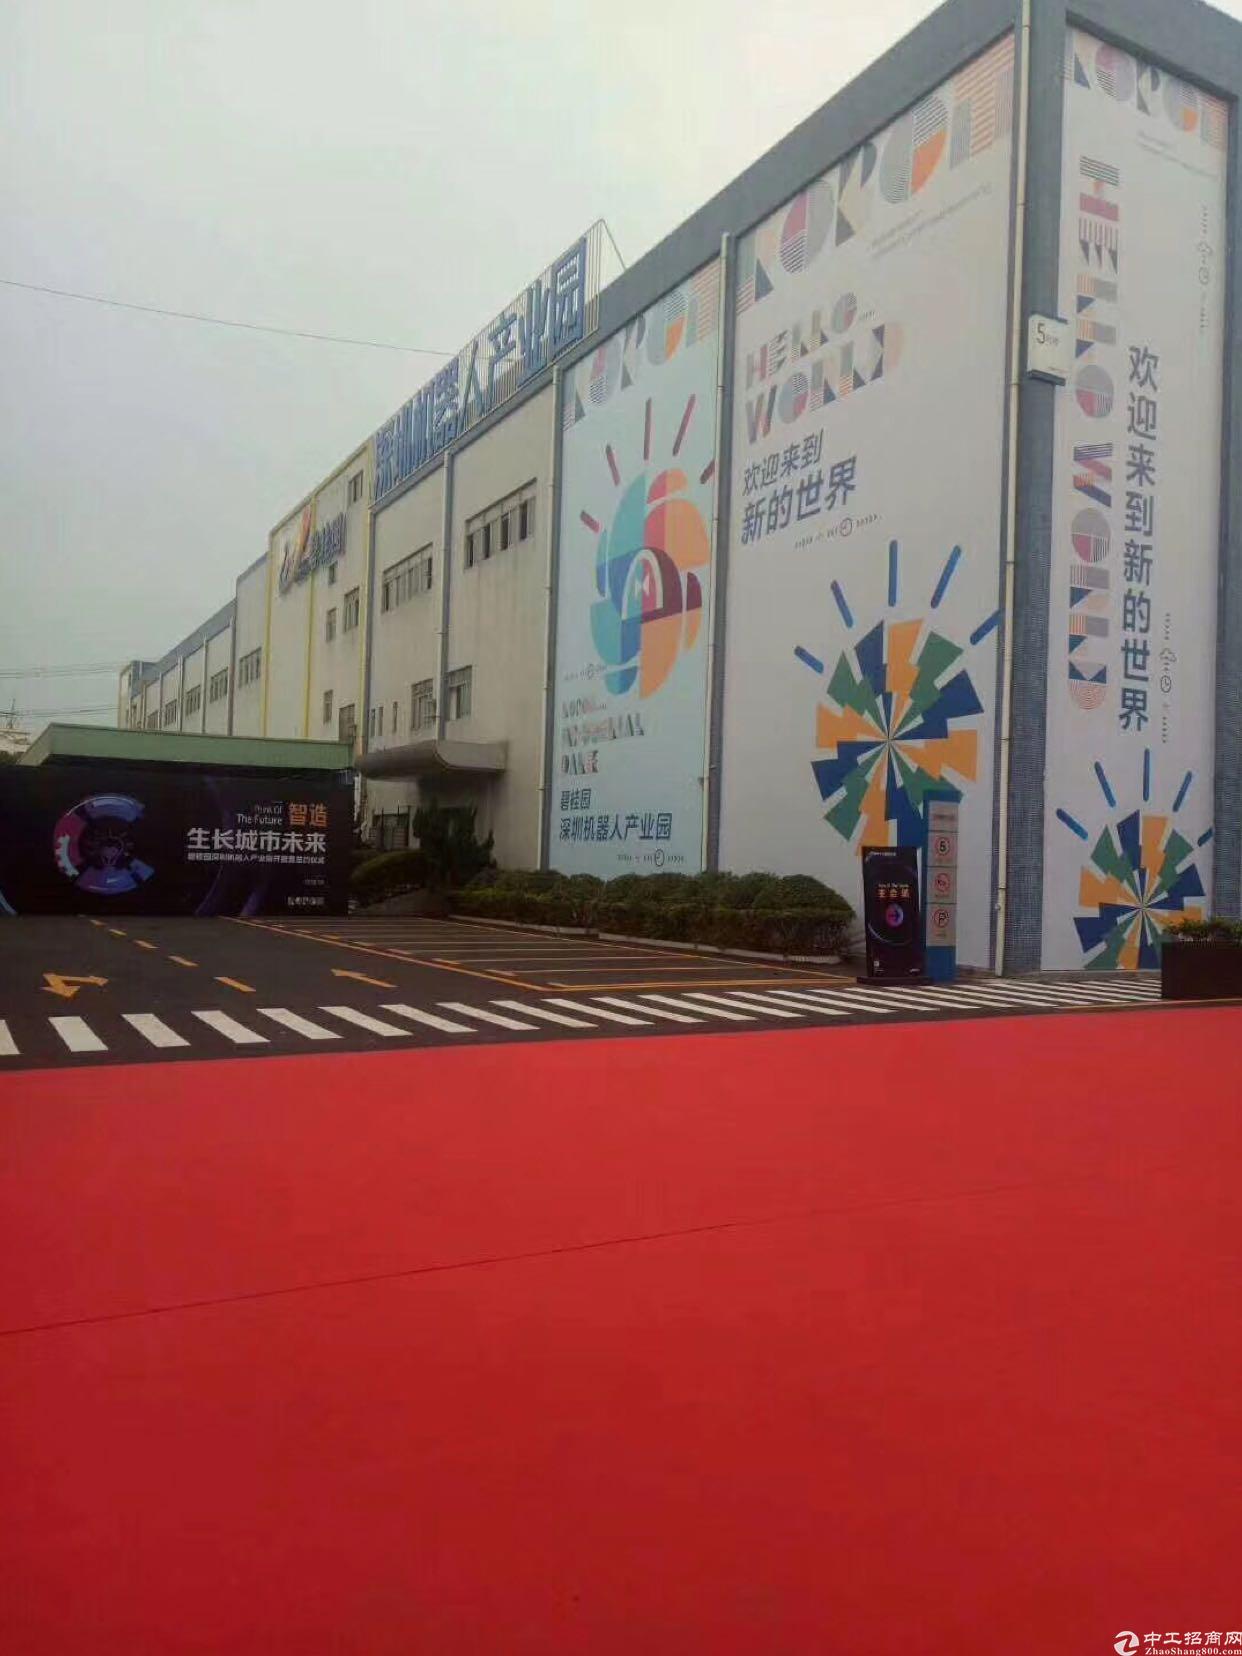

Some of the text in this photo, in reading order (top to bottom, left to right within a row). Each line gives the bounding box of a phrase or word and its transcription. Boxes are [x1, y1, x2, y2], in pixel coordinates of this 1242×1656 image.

[745, 291, 858, 392] HELLO
[744, 322, 904, 445] WORLD
[740, 455, 858, 546] 新的世界
[742, 427, 824, 497] 欢迎来到
[1117, 345, 1159, 733] 欢迎来到新的世界
[187, 827, 327, 854] 生长城市未来
[288, 802, 328, 828] 智造
[559, 812, 673, 842] 深圳机器人产业园
